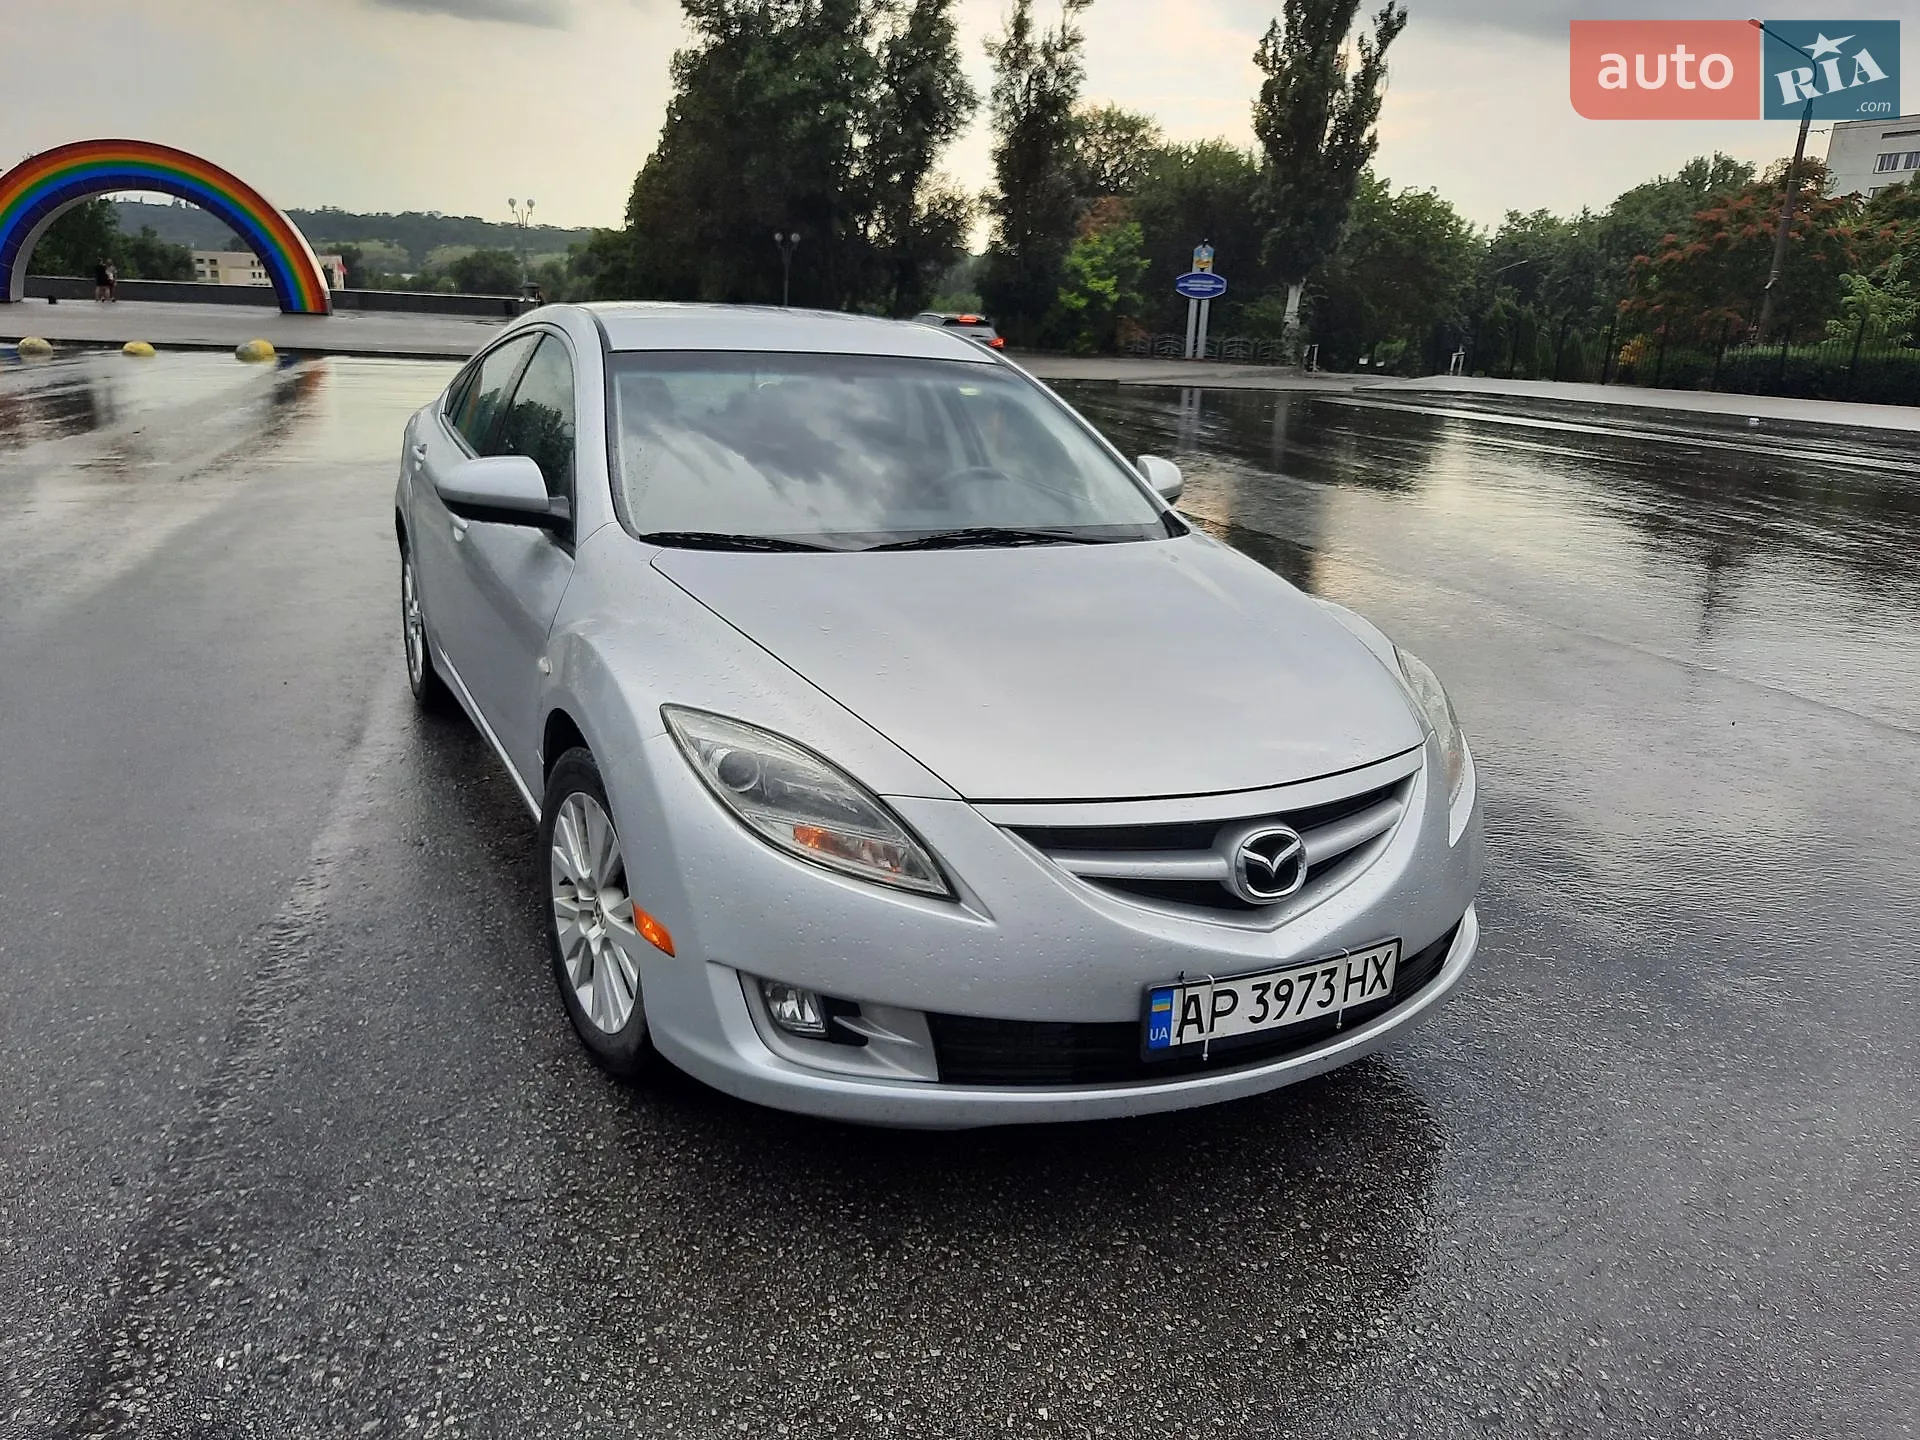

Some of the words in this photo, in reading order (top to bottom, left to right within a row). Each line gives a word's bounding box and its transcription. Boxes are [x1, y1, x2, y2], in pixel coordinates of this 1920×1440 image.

[1176, 988, 1239, 1038] AP
[1248, 967, 1338, 1024] 3973
[1343, 950, 1392, 1003] HX
[1150, 1027, 1168, 1041] UA
